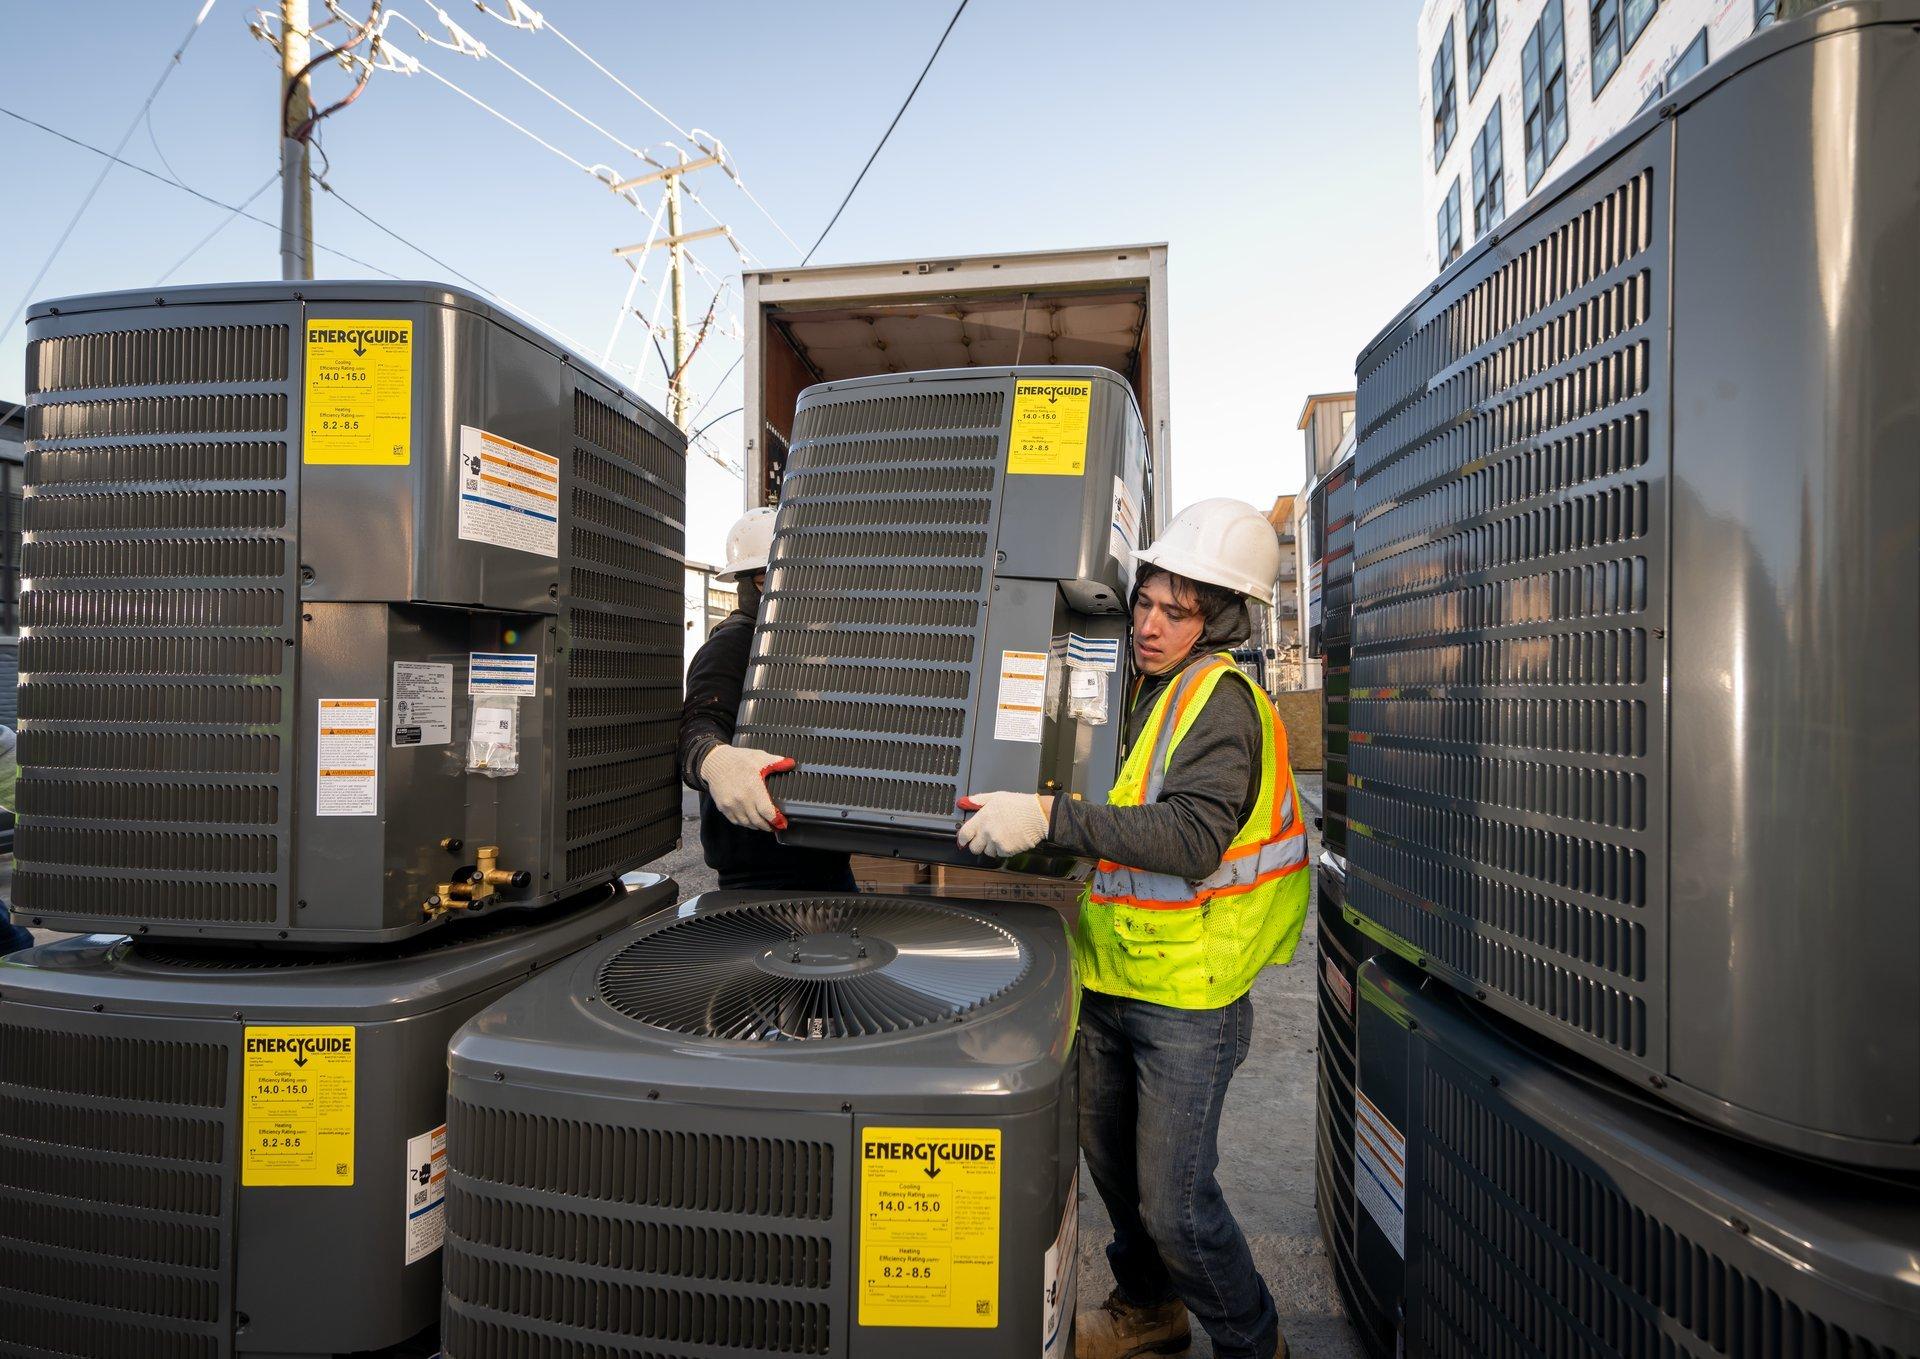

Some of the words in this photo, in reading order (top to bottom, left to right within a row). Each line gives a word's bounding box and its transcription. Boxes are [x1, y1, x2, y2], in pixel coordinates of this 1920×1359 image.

[309, 330, 408, 348] ENERGYGUIDE
[1017, 386, 1088, 398] ENERGYGUIDE
[247, 1038, 351, 1058] ENERGYGUIDE
[865, 1142, 996, 1168] ENERGYGUIDE
